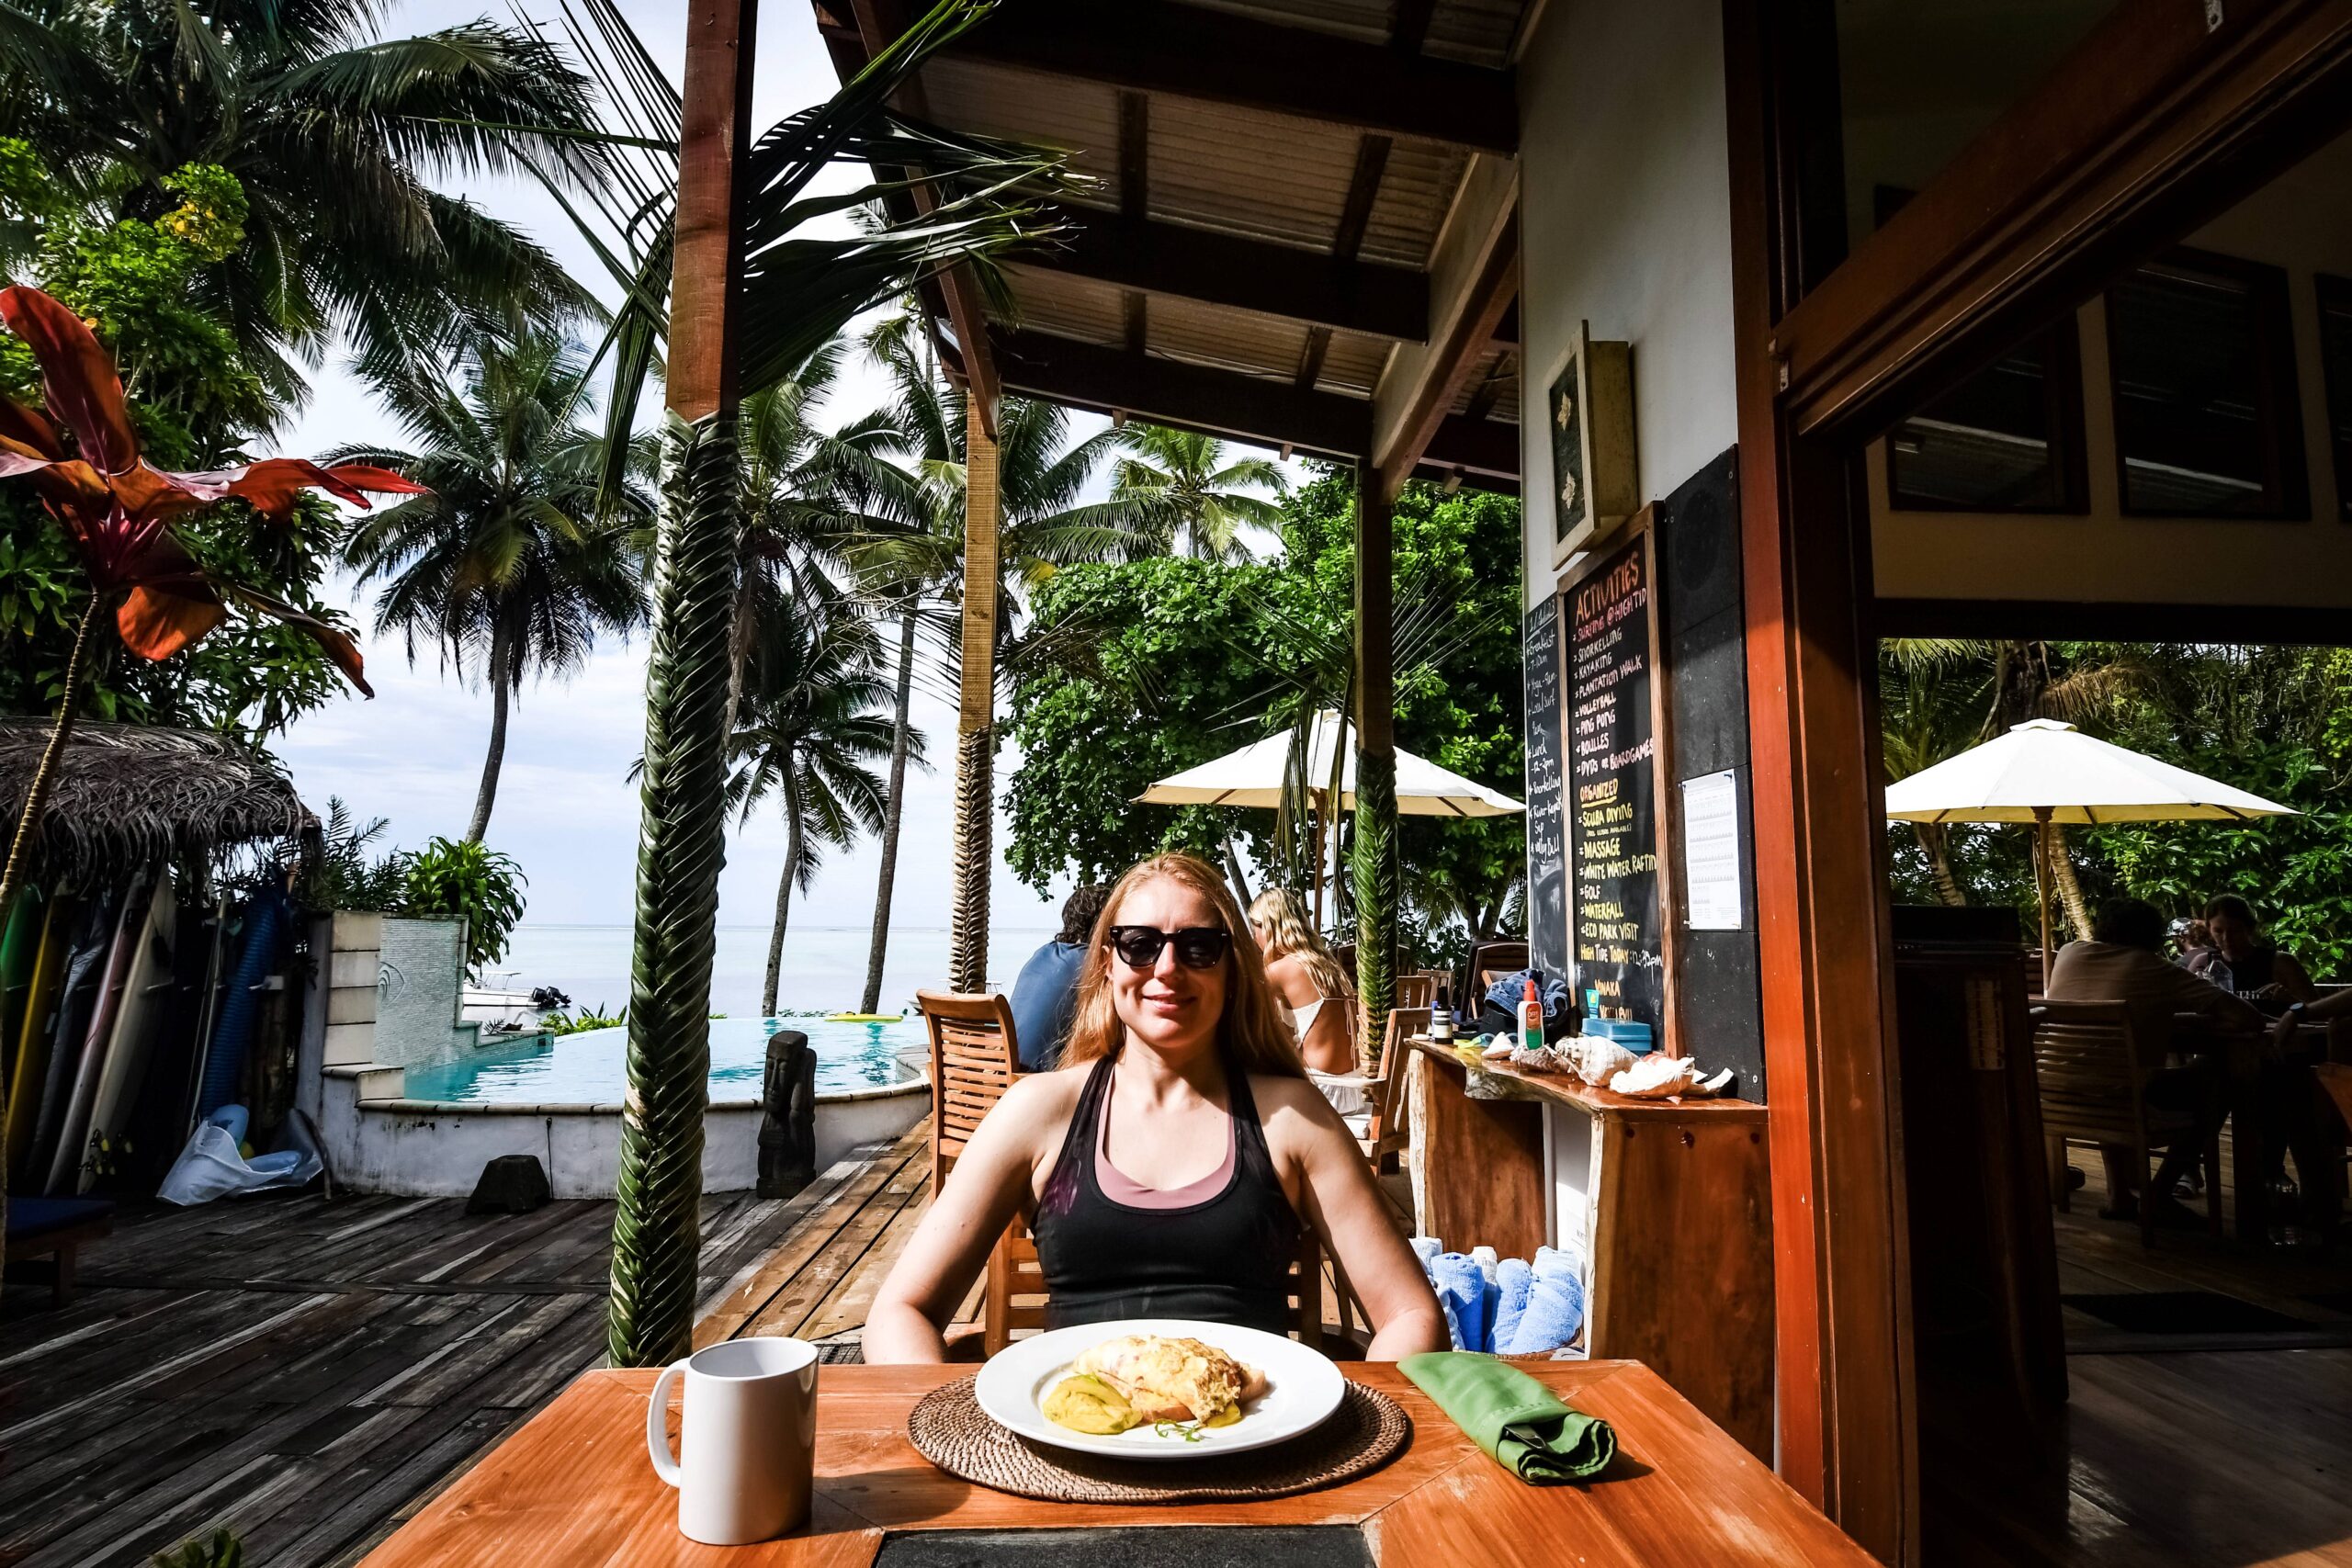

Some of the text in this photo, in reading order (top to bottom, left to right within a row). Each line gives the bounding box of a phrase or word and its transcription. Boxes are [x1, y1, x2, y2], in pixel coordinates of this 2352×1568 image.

[1576, 551, 1638, 626] ACTIVITIES
[1577, 615, 1604, 642] SURFING
[1578, 626, 1622, 662] SNORKELLING
[1579, 651, 1612, 680] KAYAKING
[1579, 654, 1642, 698] PLANTATION WALK
[1579, 691, 1616, 716] VOLLEYBALL
[1580, 709, 1616, 736] PING PONG
[1610, 738, 1654, 771] BOARDGAMES
[1580, 778, 1618, 801] ORGANIZED
[1582, 802, 1633, 827] SCUBA DIVING
[1583, 837, 1621, 860] MASSAGE
[1583, 853, 1657, 880] WHITE WATER RAFTIN
[1584, 884, 1600, 900] GOLF
[1585, 901, 1624, 920] WATERFALL
[1585, 921, 1639, 942] ECO PARK VISIT
